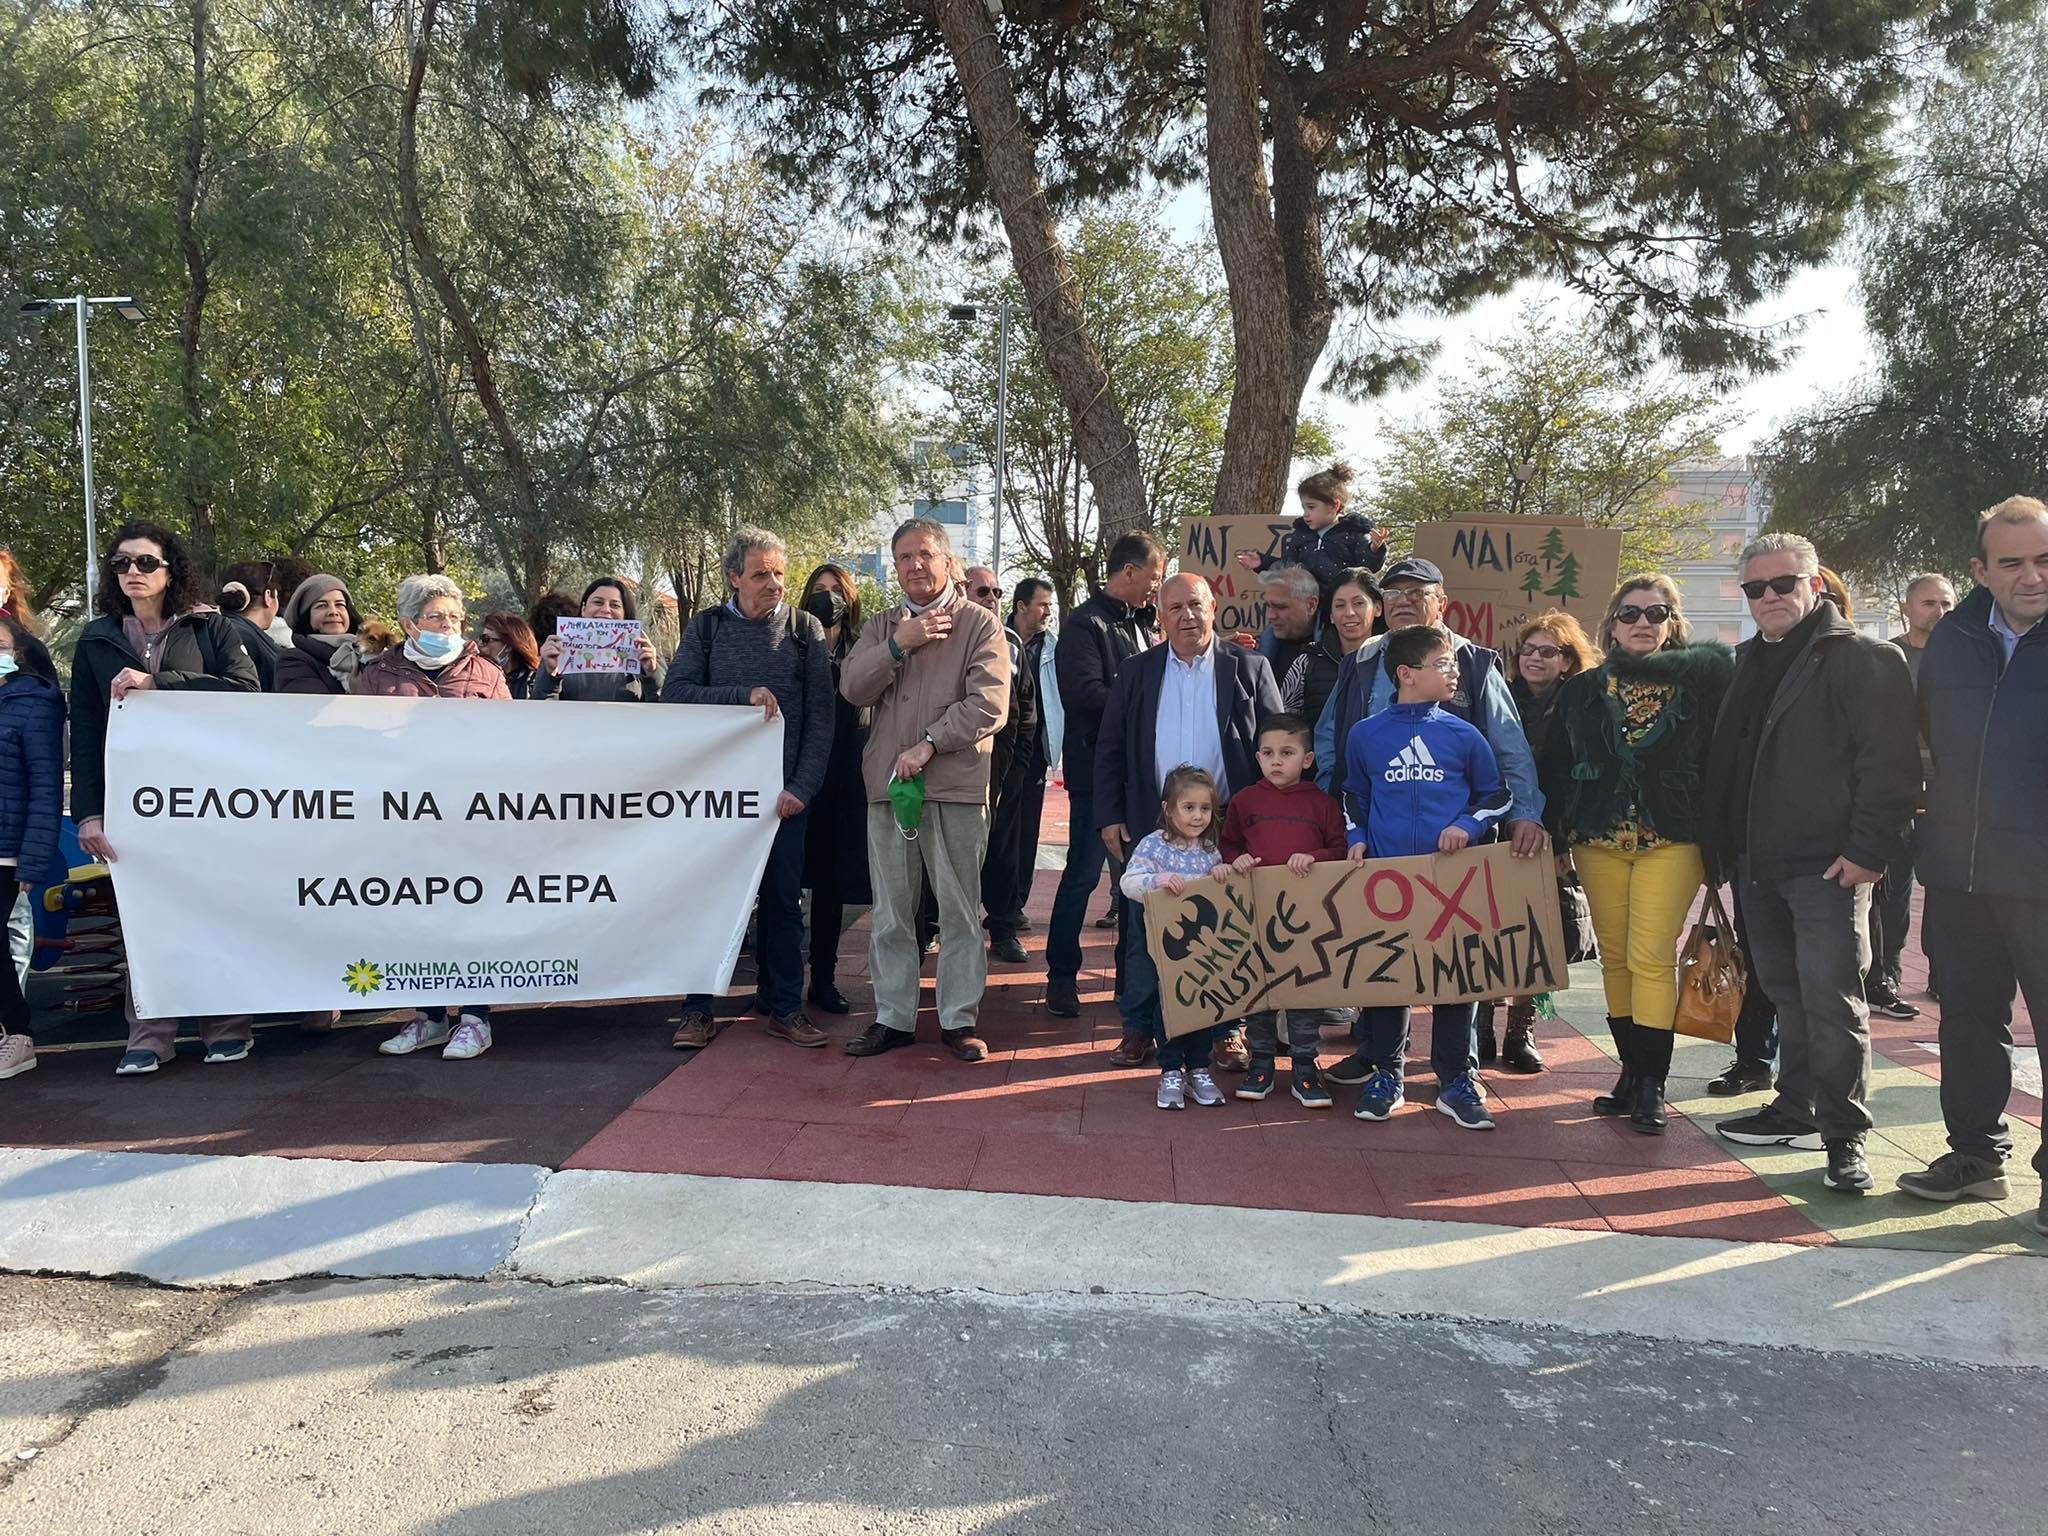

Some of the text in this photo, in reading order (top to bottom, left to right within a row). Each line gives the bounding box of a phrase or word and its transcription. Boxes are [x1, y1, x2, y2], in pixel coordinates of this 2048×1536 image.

[1452, 525, 1513, 572] ΝΑΙ
[1206, 573, 1235, 598] ΧΙ
[1443, 600, 1493, 648] ΟΧΙ
[1384, 764, 1445, 783] adidas
[132, 786, 759, 821] ΘΕΛΟΥΜΕ ΝΑ ΑΝΑΠΝΕΟΥΜΕ
[298, 874, 617, 906] ΚΑΘΑΡΟ ΑΕΡΑ
[1364, 856, 1501, 942] ΟΧΙ
[1175, 884, 1255, 1007] CLIMATE
[1199, 890, 1311, 1022] JUSTICE
[1336, 897, 1556, 997] ΤΣΙΜΕΝΤΑ
[385, 959, 578, 976] ΚΙΝΗΜΑ ΟΙΚΟΛΟΓΩΝ
[385, 974, 578, 991] ΣΥΝΕΡΓΑΣΙΑ ΠΟΛΙΤΩΝ
